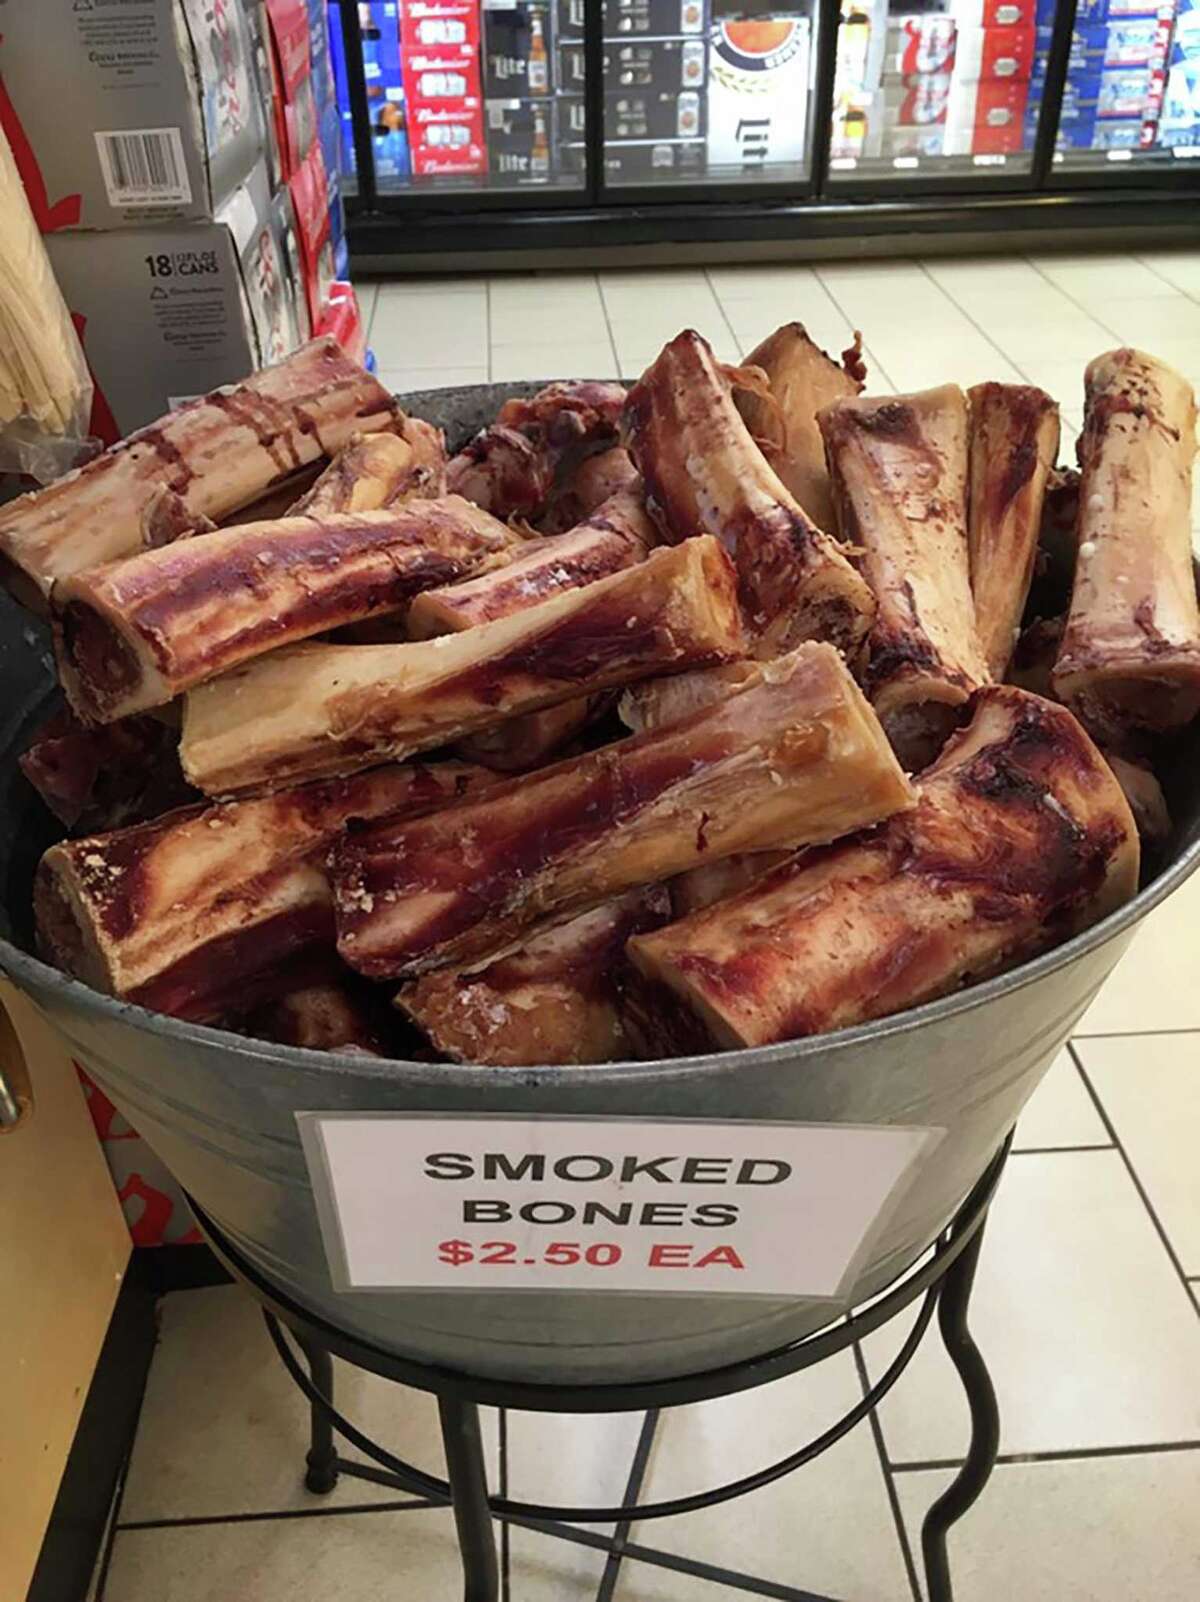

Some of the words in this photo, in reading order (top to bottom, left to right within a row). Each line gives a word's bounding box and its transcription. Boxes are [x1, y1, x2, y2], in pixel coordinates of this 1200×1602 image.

[145, 254, 172, 277] 18
[179, 262, 218, 276] CANS
[423, 1152, 793, 1186] SMOKED
[462, 1199, 740, 1228] BONES
[438, 1239, 622, 1267] $2.50
[647, 1244, 745, 1269] EA
